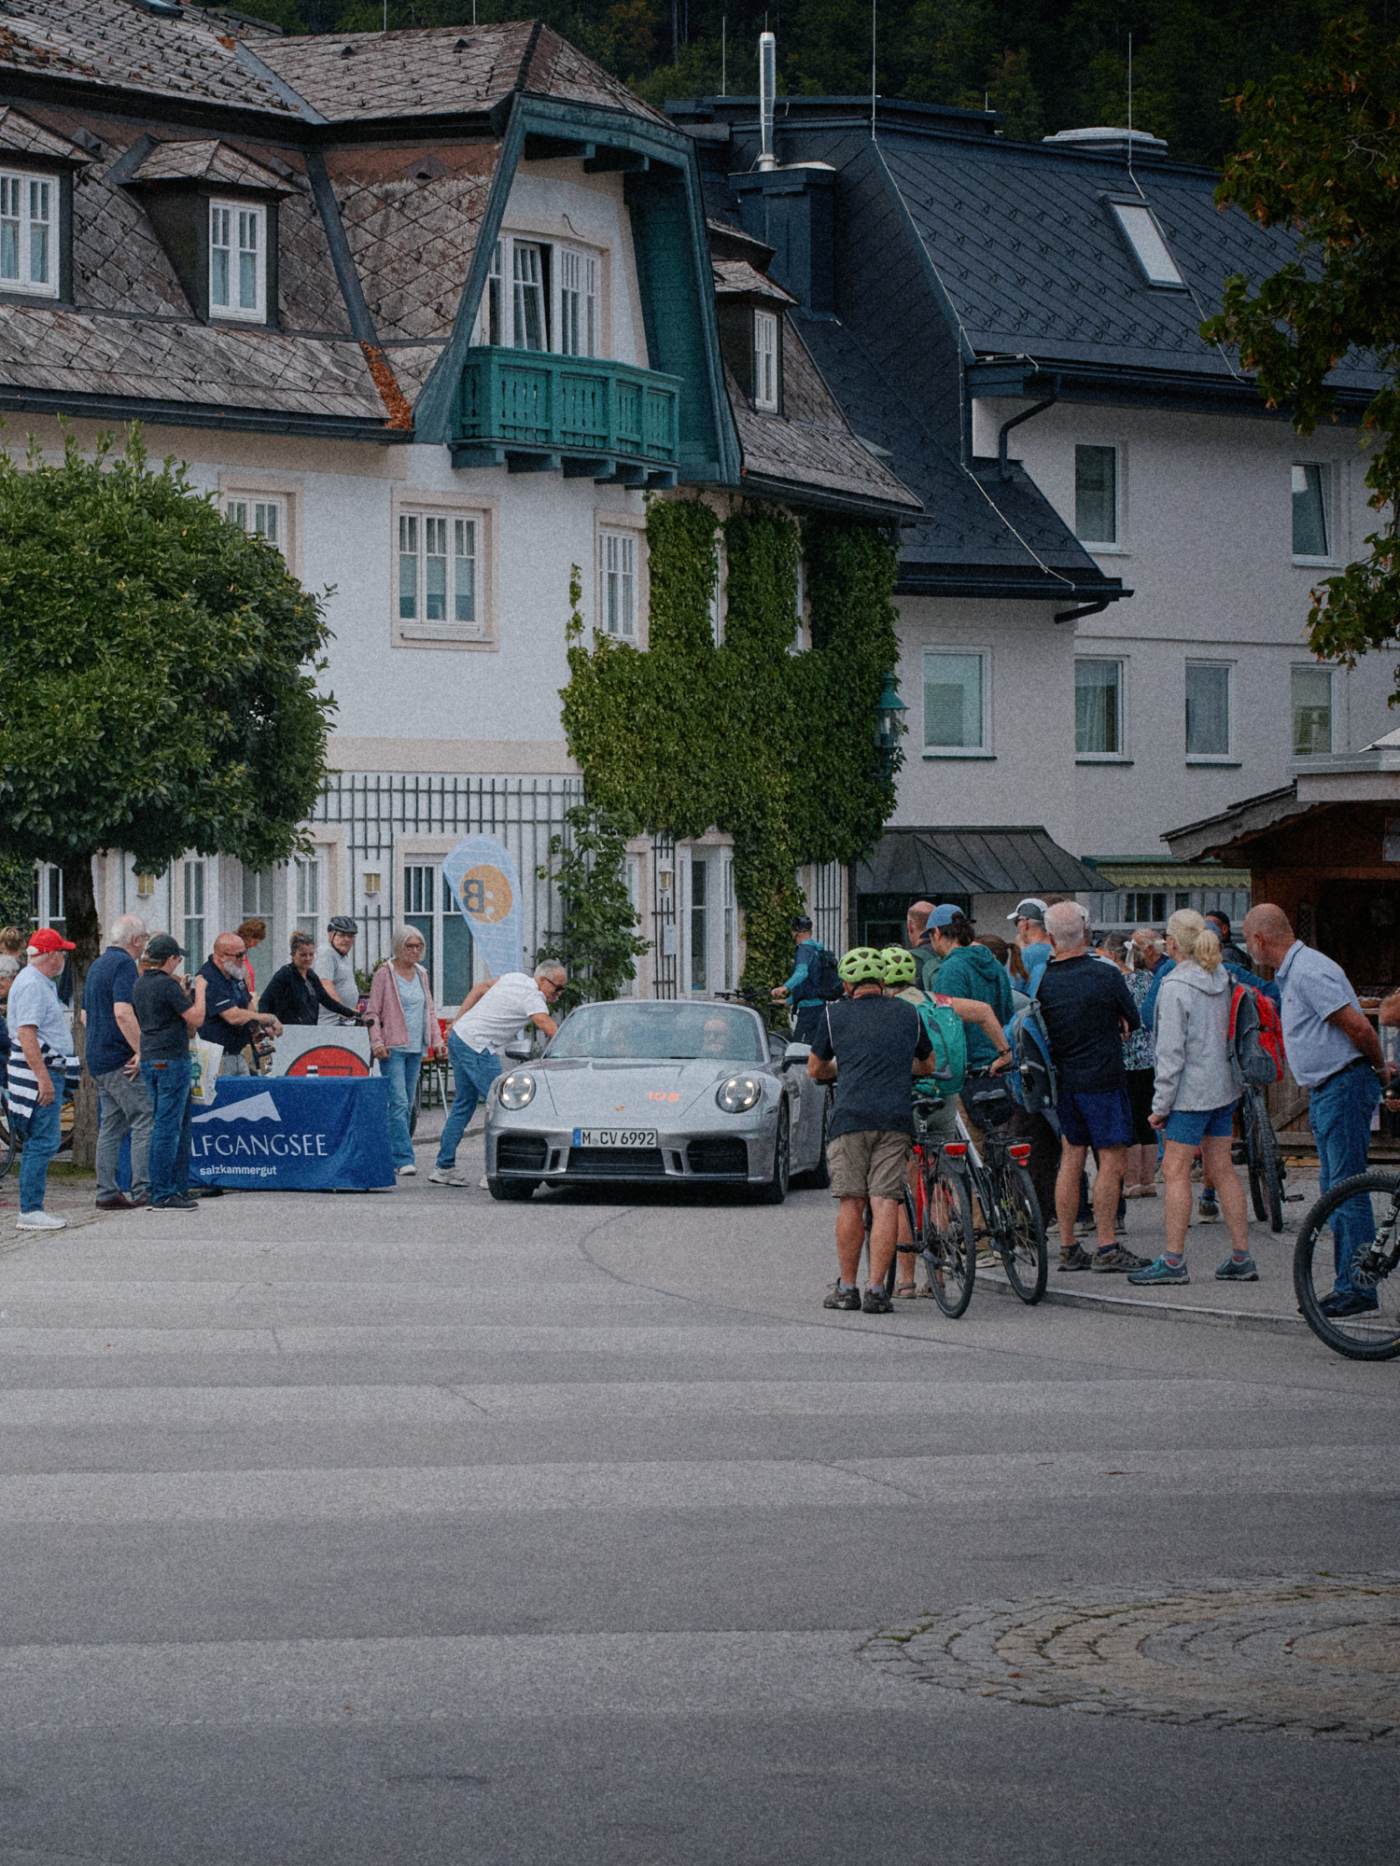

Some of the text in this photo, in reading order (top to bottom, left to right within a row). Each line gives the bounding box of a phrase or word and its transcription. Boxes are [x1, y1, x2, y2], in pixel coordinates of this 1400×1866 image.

[647, 1091, 679, 1102] 108
[191, 1134, 328, 1157] LFGANGSEE
[582, 1131, 655, 1146] M CV 6992
[199, 1164, 277, 1177] salzkammergut
